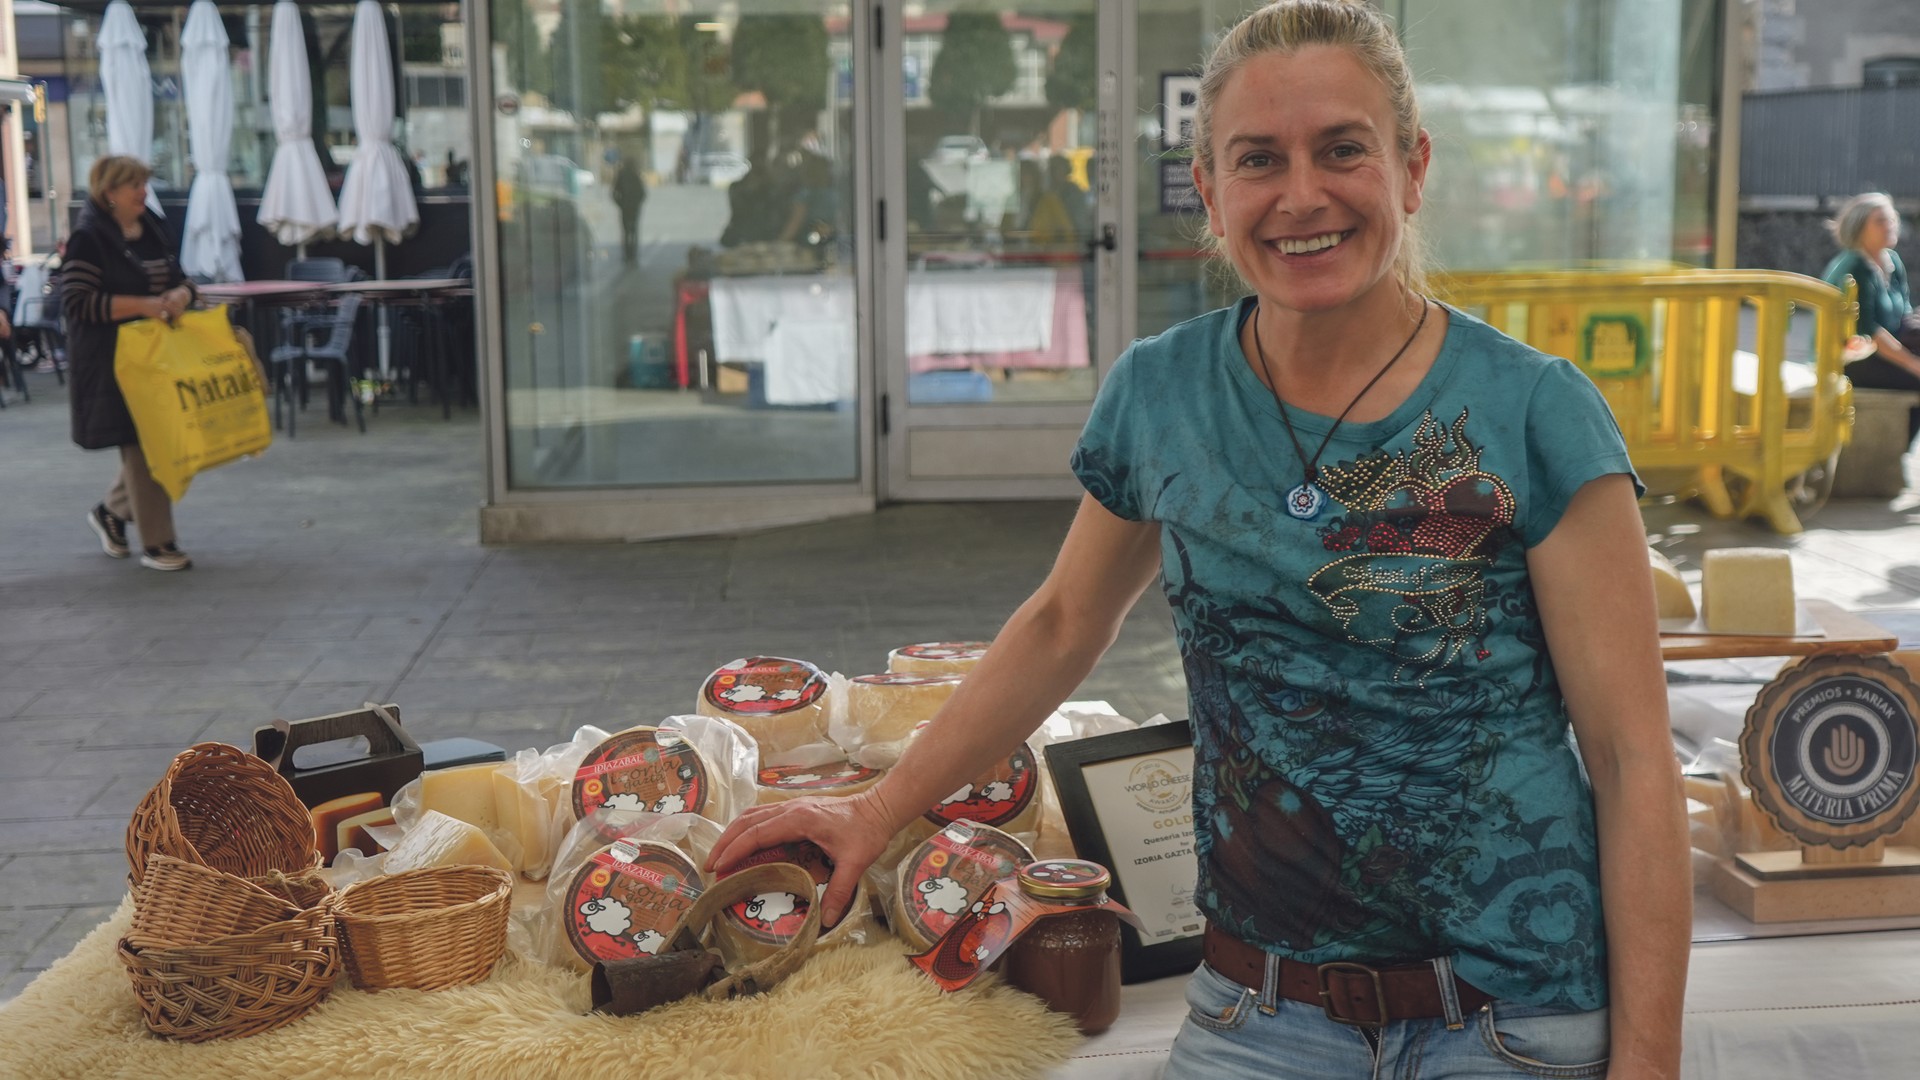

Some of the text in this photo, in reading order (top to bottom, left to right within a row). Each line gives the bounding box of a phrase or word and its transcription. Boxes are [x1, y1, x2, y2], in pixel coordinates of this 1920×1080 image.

[1792, 687, 1896, 723] PREMIOS SARIAK
[593, 755, 642, 774] IDIAZABAL
[1785, 769, 1905, 818] MATERIA PRIMA
[1153, 815, 1193, 829] GOLD
[950, 842, 996, 866] IDIAZABAL
[1134, 848, 1193, 866] IZORIA GAZTA
[611, 860, 662, 884] IDIAZABAL
